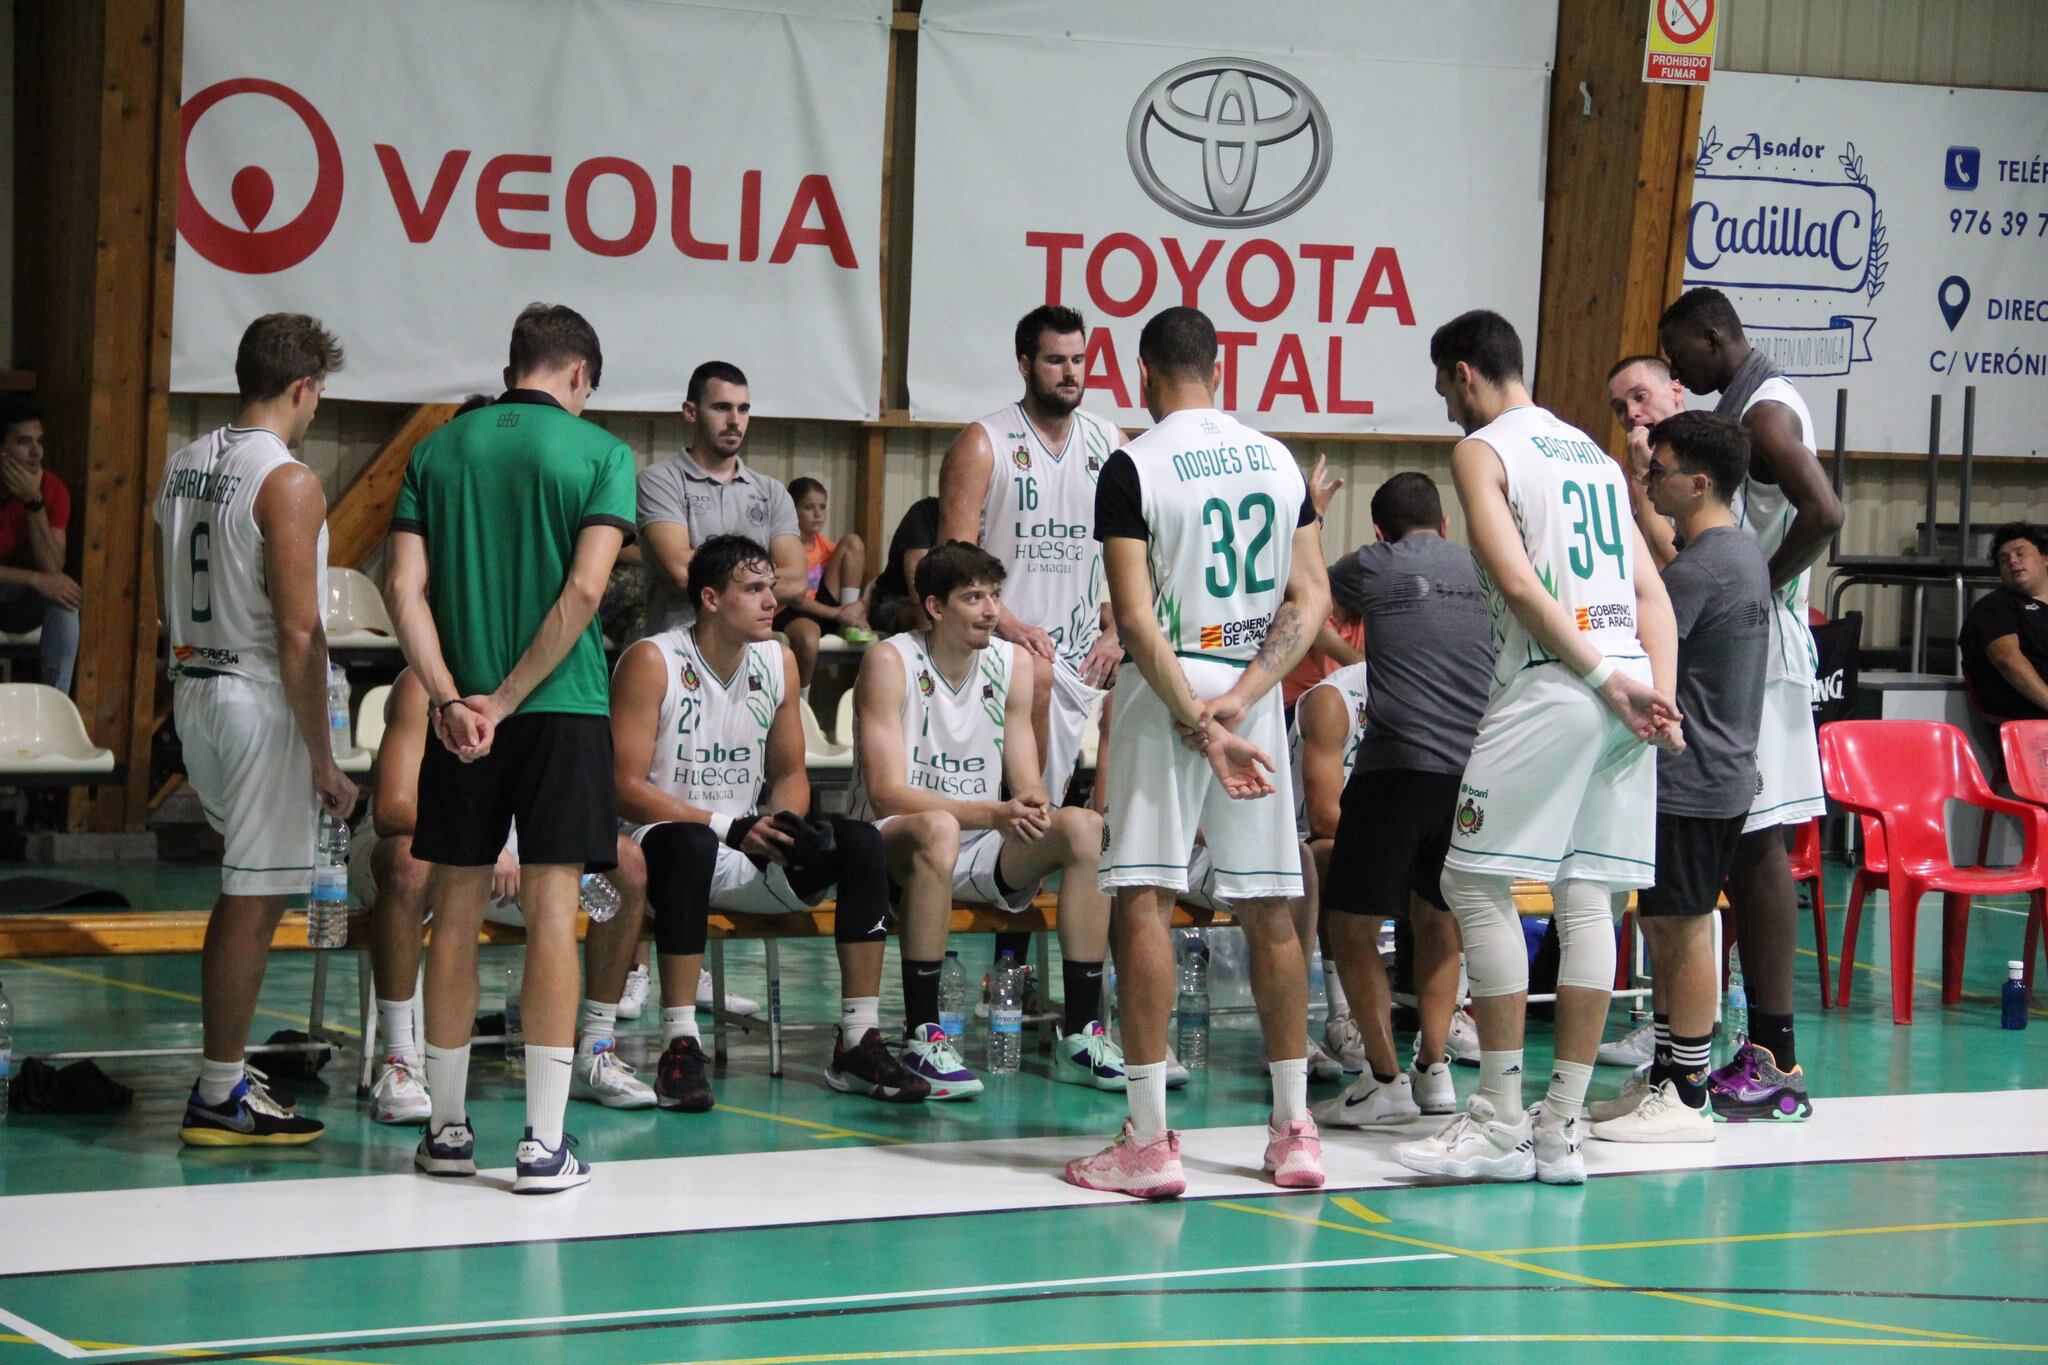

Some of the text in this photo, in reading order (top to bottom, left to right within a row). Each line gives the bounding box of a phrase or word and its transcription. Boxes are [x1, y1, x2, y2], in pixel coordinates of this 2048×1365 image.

[1652, 55, 1707, 68] PROHIBIDO
[1661, 67, 1696, 79] FUMAR
[1726, 133, 1825, 160] Asador
[373, 143, 859, 269] VEOLIA
[1949, 208, 1992, 235] 976
[2001, 211, 2028, 237] 39
[1026, 231, 1417, 326] TOYOTA
[1083, 326, 1374, 414] ATAL
[1929, 346, 2047, 376] C/ VERÓNI
[1172, 441, 1243, 482] NOGUÉS
[1531, 436, 1611, 465] BASTANT
[1014, 477, 1039, 511] 16
[1015, 518, 1087, 539] Lobe
[1562, 479, 1626, 580] 34
[1014, 541, 1084, 561] Huesca
[1202, 492, 1276, 599] 32
[190, 521, 212, 623] 6
[1223, 612, 1272, 635] GOBIERNO
[1589, 604, 1631, 618] GOBIERNO
[1591, 617, 1605, 629] DE
[1223, 633, 1240, 647] DE
[677, 697, 701, 734] 27
[676, 743, 751, 763] Lobe
[673, 766, 750, 787] Huesca
[1468, 785, 1489, 798] barri
